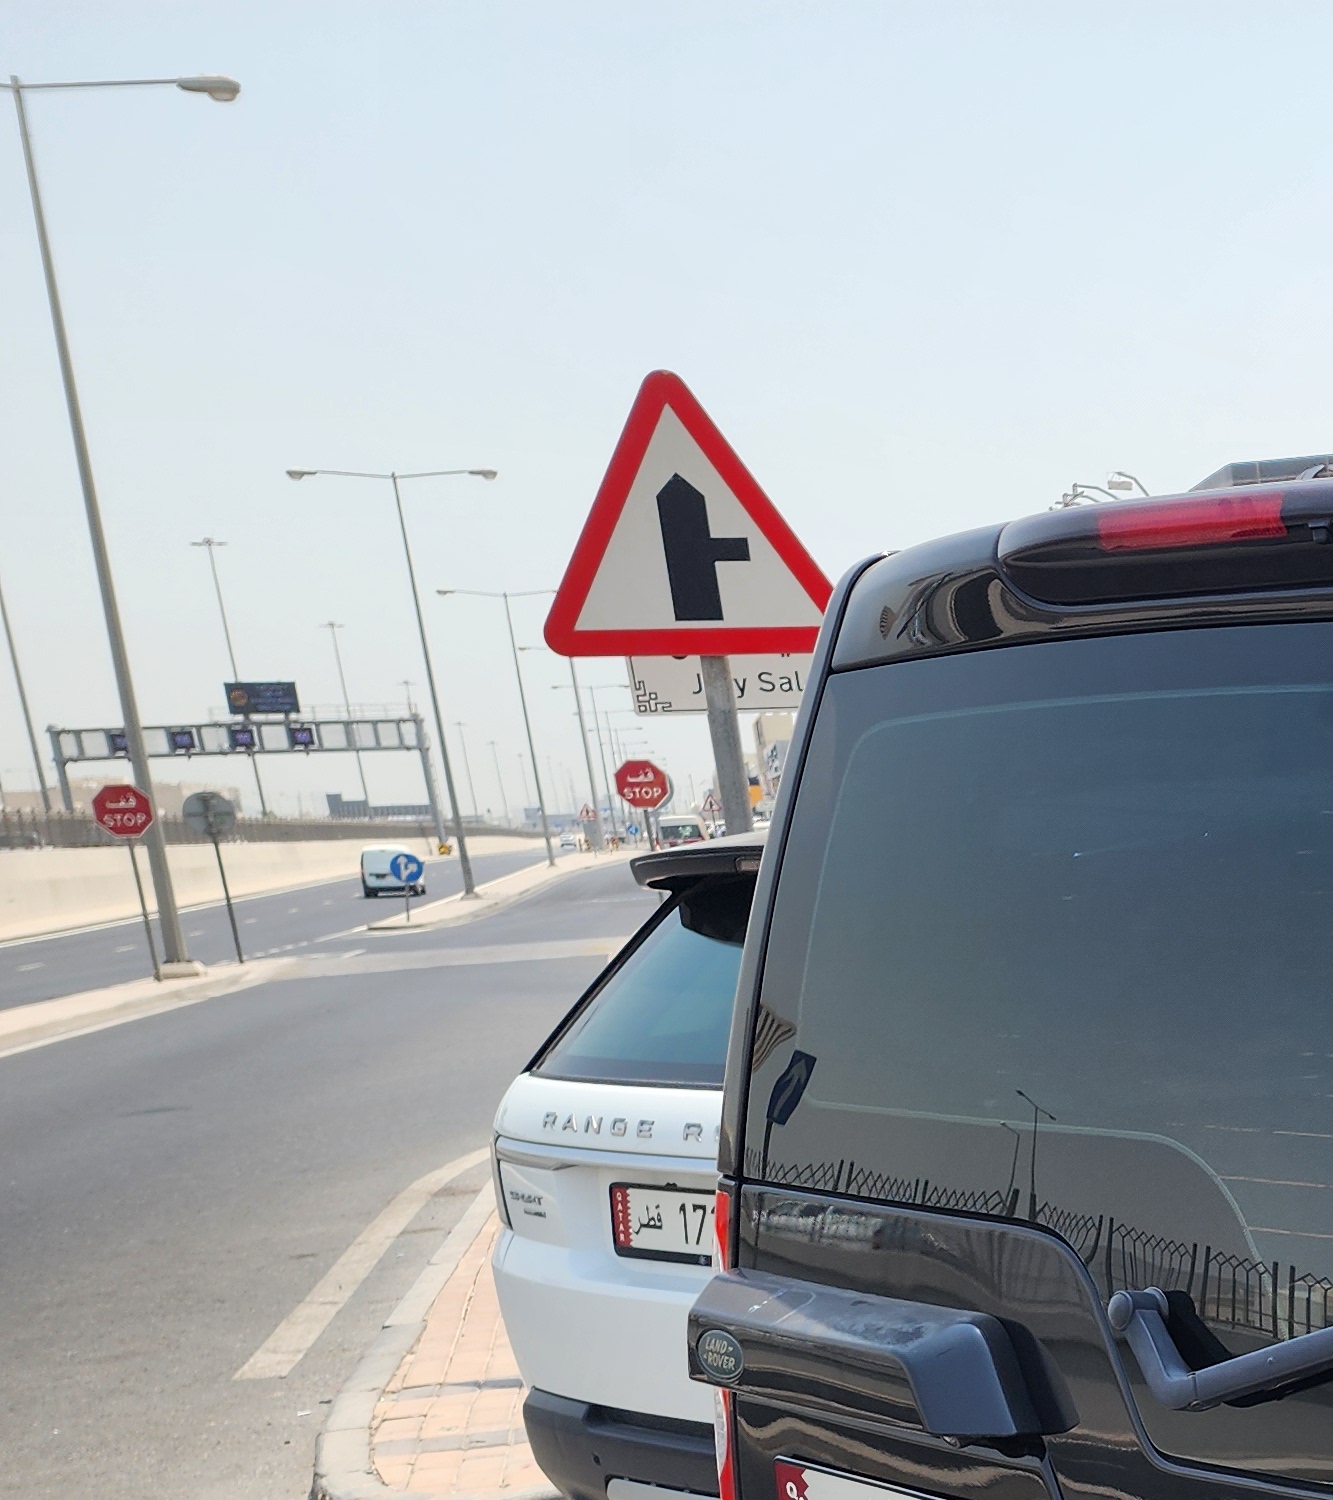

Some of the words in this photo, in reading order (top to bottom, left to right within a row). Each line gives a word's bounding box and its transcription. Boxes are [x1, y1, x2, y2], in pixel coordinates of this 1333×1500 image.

[693, 673, 747, 698] Jy
[758, 670, 804, 692] Sal
[622, 786, 662, 799] STOP
[103, 812, 146, 828] STOP
[542, 1111, 655, 1138] RANGE
[683, 1122, 720, 1143] R
[616, 1191, 625, 1243] QATAR
[634, 1203, 664, 1236] قطر
[679, 1202, 716, 1246] 17
[705, 1336, 728, 1354] LAND
[707, 1351, 736, 1371] ROVER
